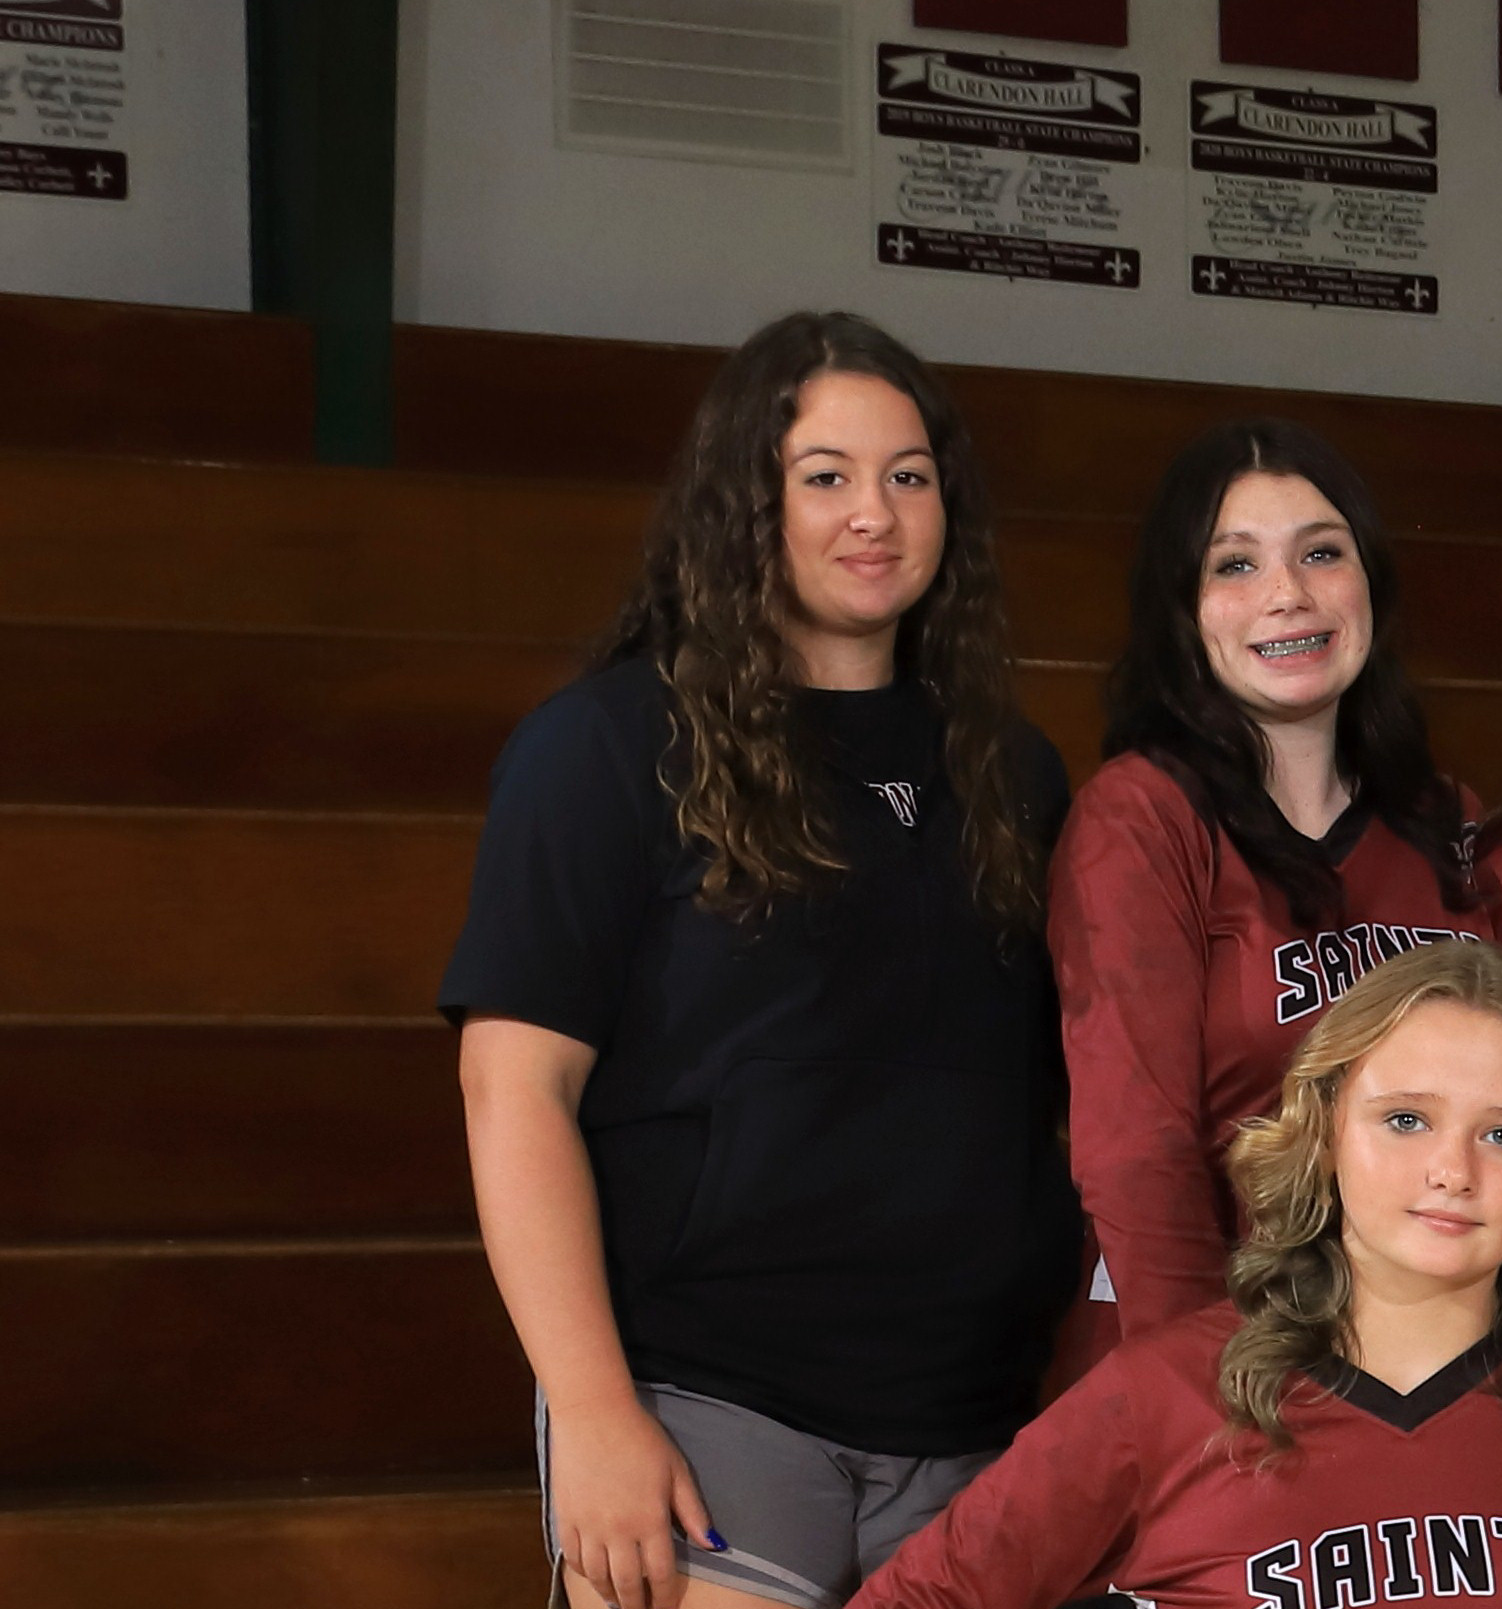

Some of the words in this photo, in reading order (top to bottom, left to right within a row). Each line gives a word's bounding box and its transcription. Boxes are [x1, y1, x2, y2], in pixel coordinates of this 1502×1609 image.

[7, 20, 118, 46] CHAMPIONS
[932, 72, 1039, 106] CLARENDON
[1042, 86, 1084, 106] HALL
[1024, 121, 1060, 139] STATE
[1243, 108, 1344, 138] CLARENDON
[1346, 119, 1385, 138] HALL
[1329, 154, 1364, 171] STATE
[1365, 157, 1431, 178] CHAMPIONS
